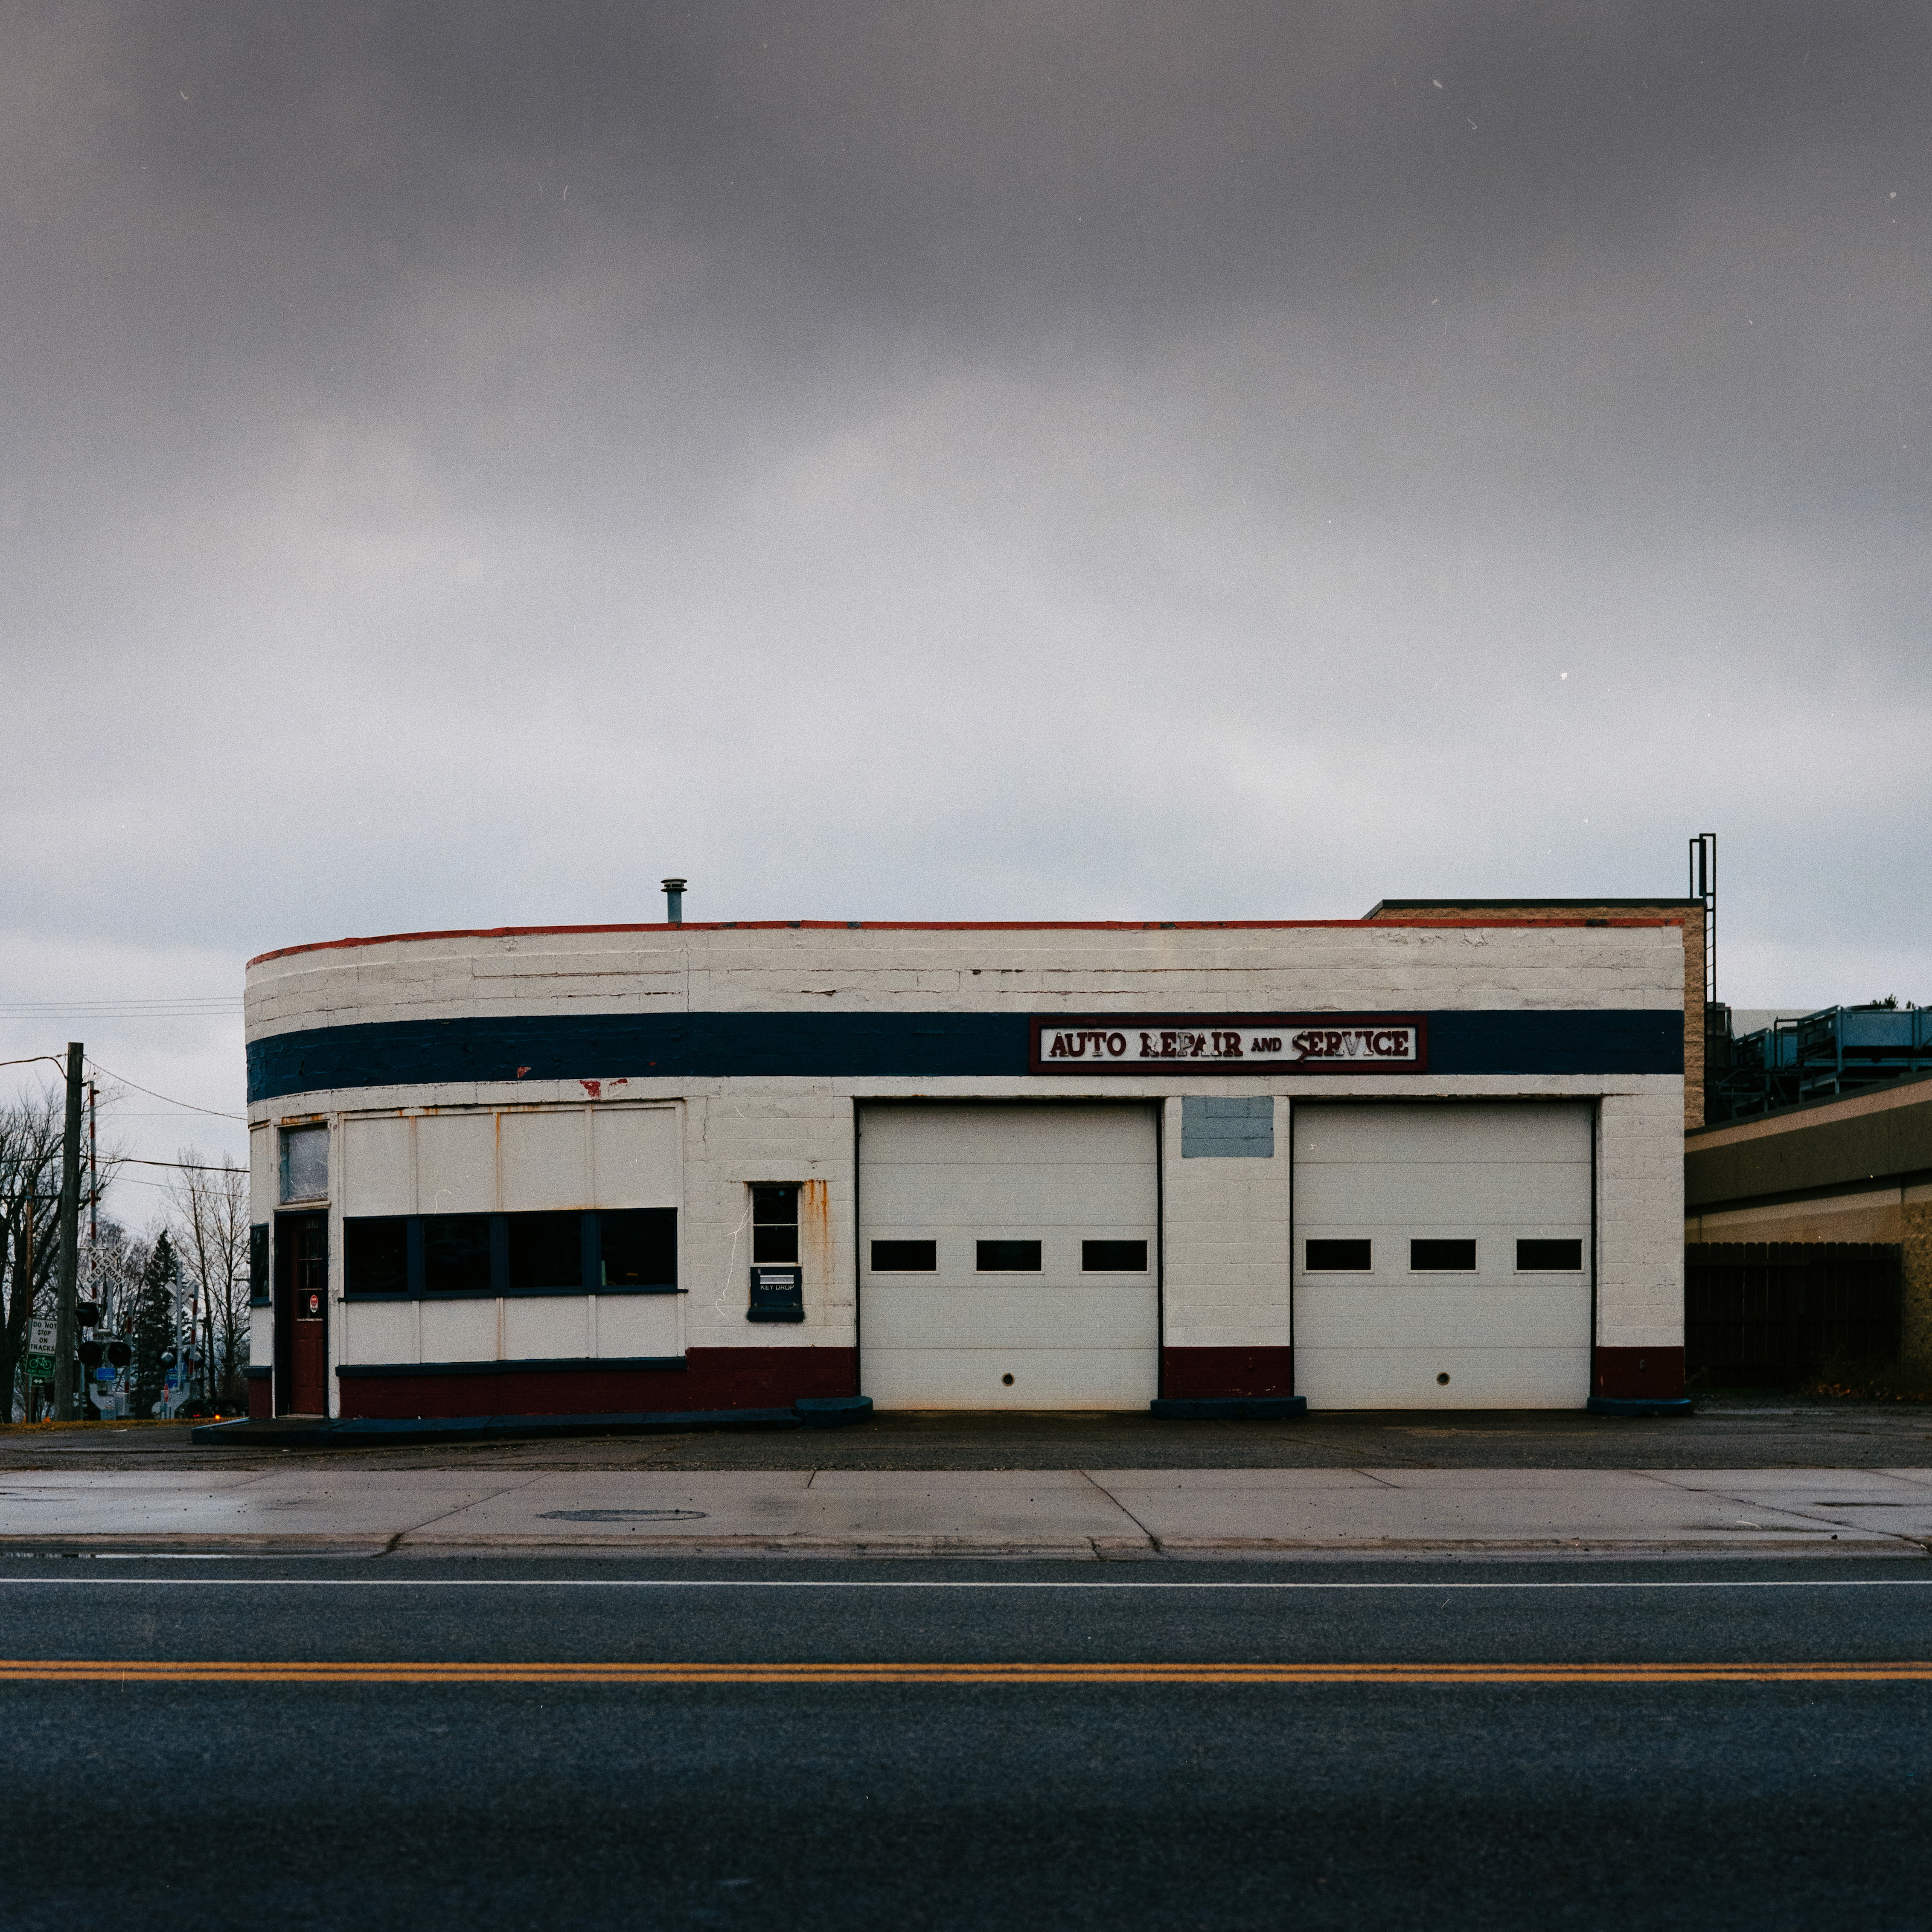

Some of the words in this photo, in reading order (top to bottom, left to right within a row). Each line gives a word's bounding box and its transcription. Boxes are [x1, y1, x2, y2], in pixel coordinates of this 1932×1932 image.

[1049, 1032, 1127, 1057] AUTO
[1140, 1032, 1244, 1057] REPAIR
[1251, 1037, 1282, 1051] AND
[1292, 1031, 1409, 1061] SERVICE
[87, 1247, 122, 1284] CROSSING
